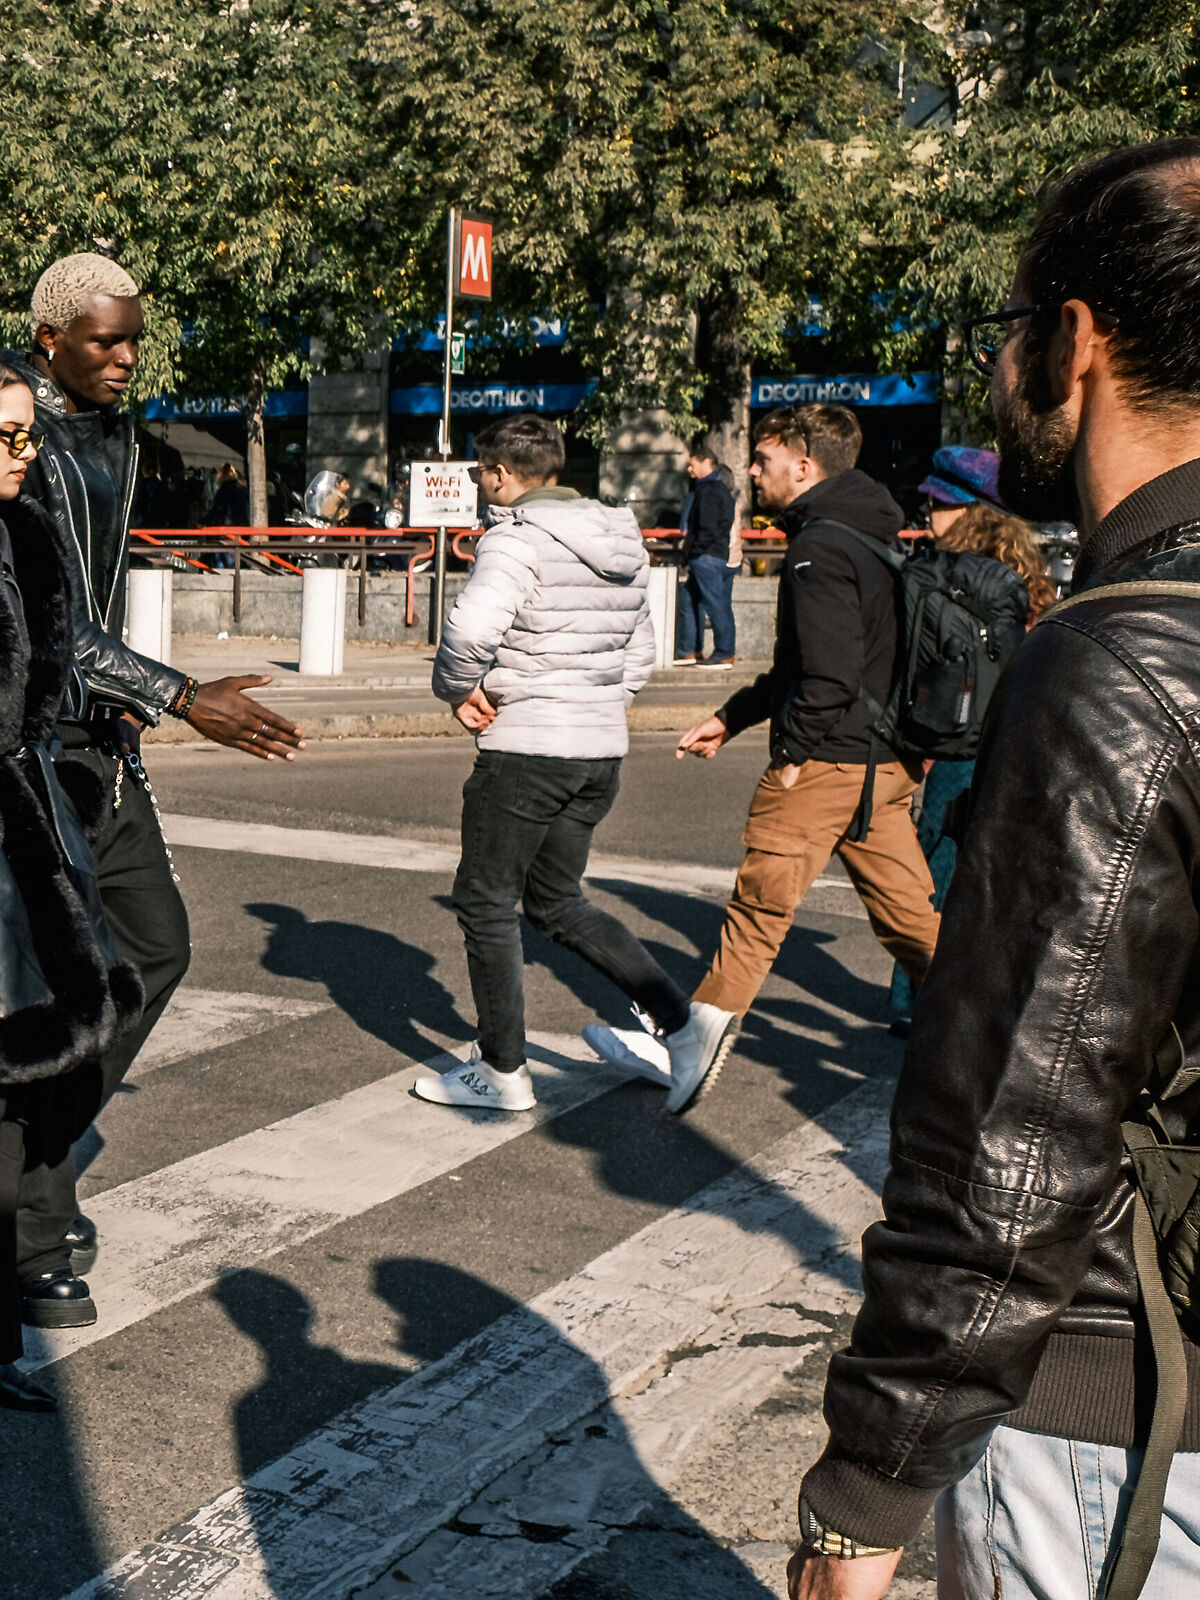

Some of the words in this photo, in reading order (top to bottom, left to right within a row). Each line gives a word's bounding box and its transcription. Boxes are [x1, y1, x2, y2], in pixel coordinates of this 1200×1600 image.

[461, 234, 489, 282] M
[758, 382, 870, 402] DECATHLON
[426, 477, 461, 487] Wi-Fi
[425, 490, 460, 498] area
